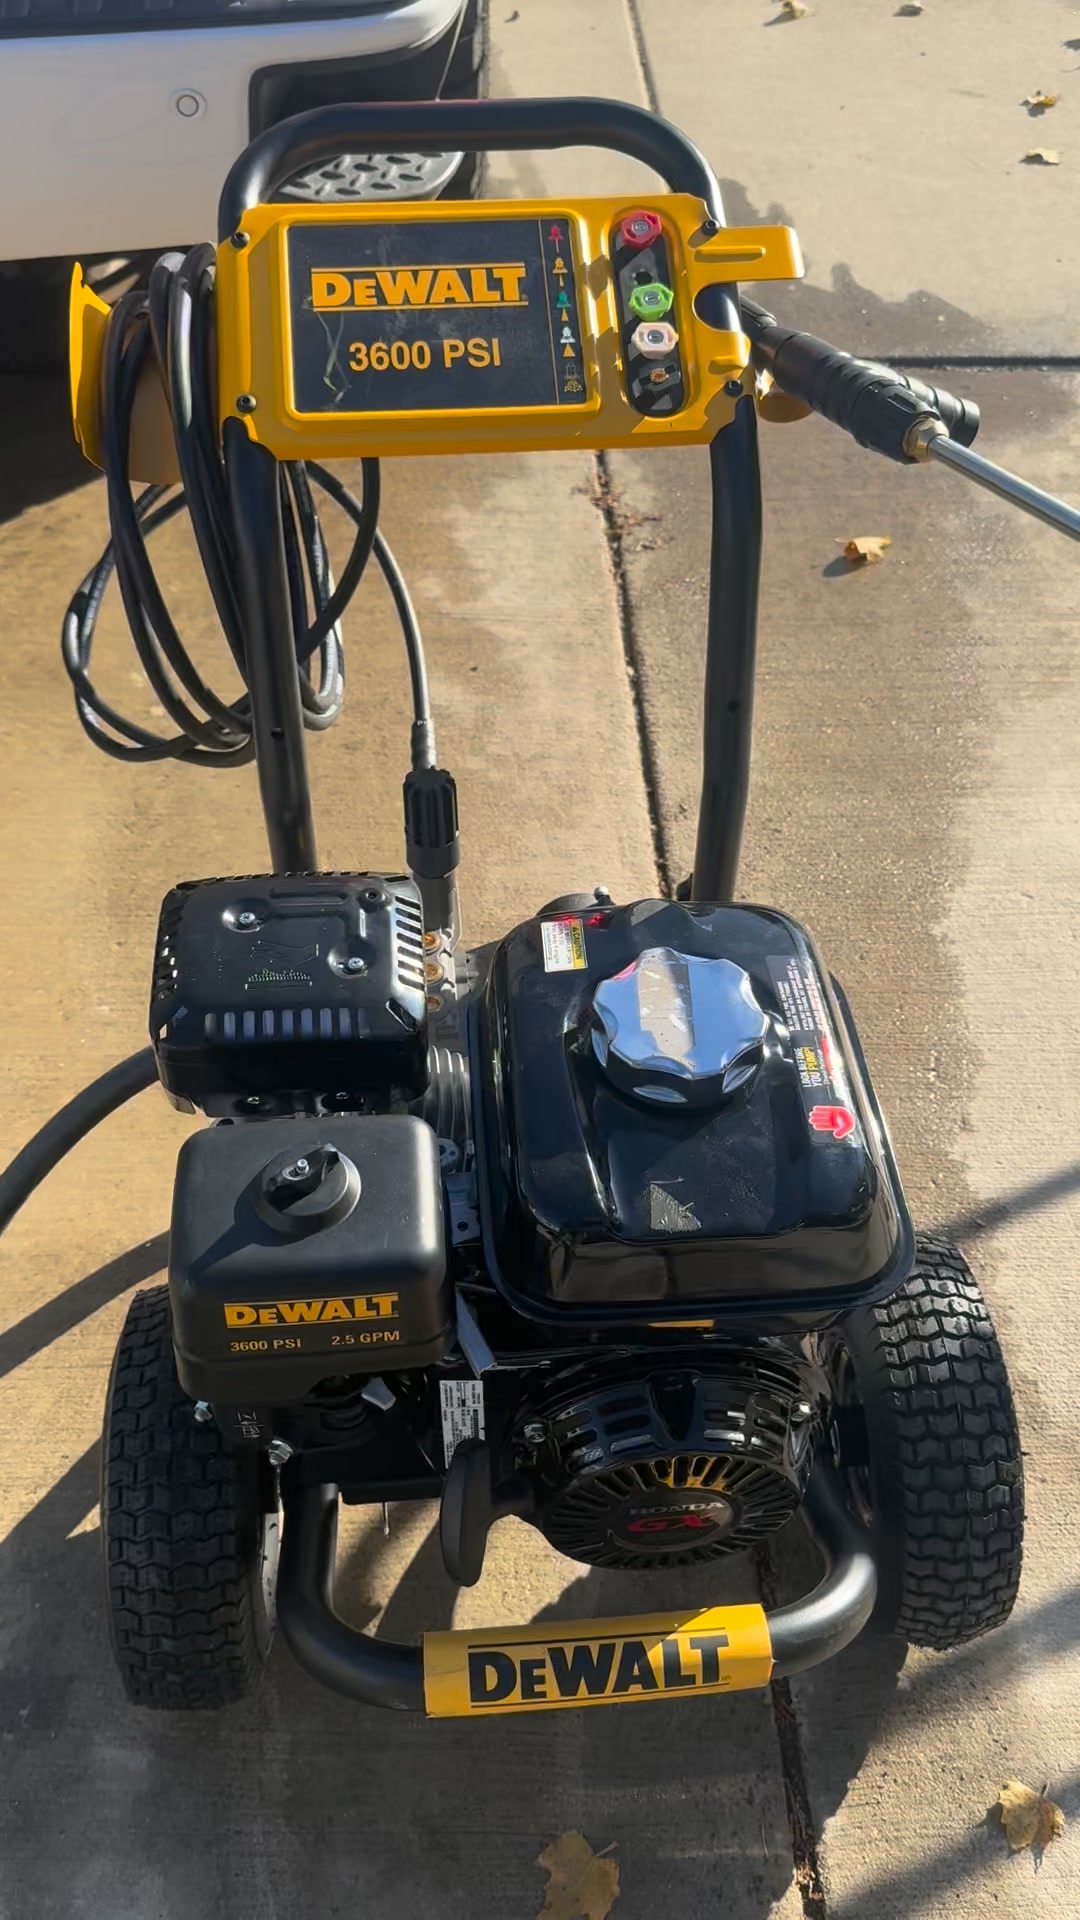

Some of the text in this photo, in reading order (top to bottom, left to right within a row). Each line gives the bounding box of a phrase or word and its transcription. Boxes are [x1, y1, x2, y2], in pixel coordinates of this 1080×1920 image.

[349, 337, 501, 372] 3600 PSI
[572, 932, 583, 960] CAUTION
[793, 1047, 812, 1088] LOOK BEFORE
[809, 1071, 823, 1087] YOU
[230, 1330, 400, 1352] 3600 PSI 2.5 GPM
[629, 1501, 727, 1514] HONDA
